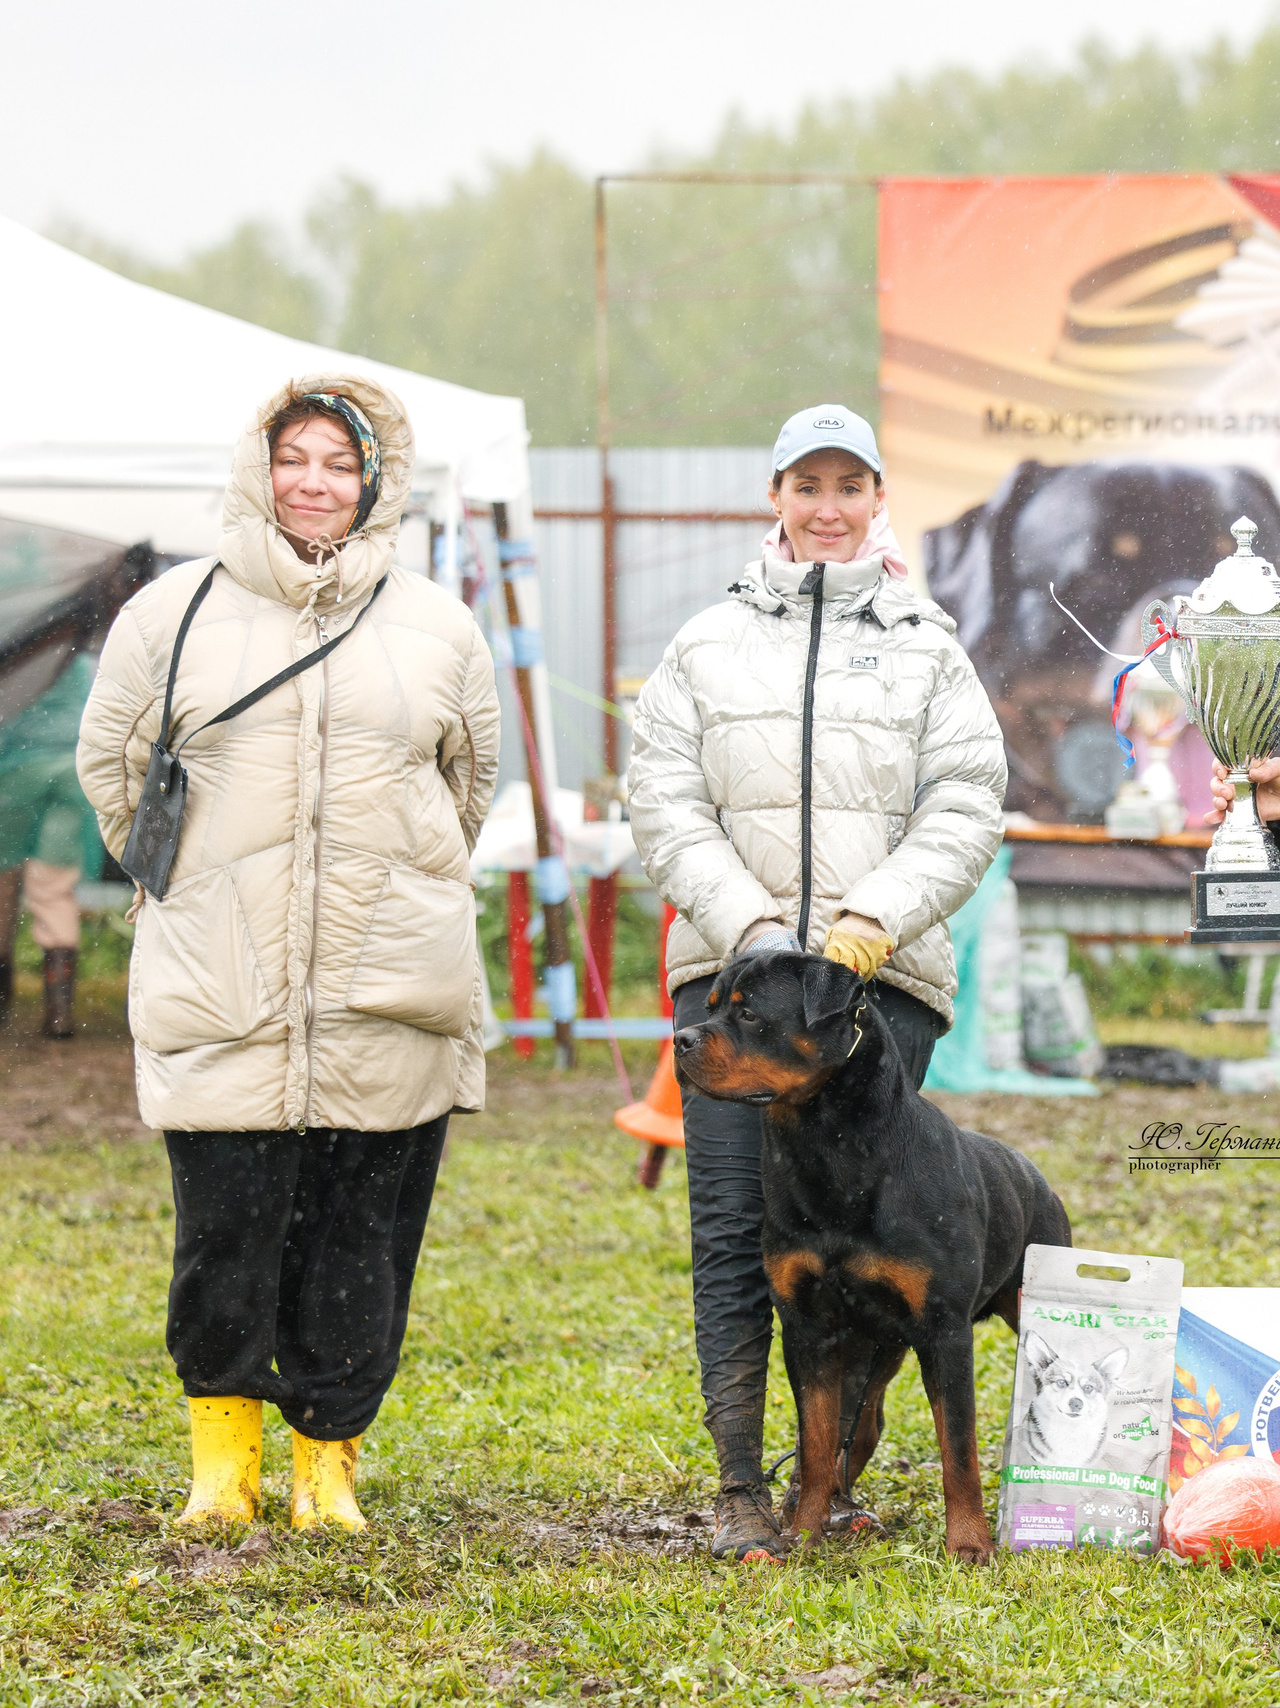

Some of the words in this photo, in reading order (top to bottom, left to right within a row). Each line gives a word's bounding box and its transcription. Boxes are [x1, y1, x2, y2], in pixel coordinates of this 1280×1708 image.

[1032, 1306, 1102, 1328] ACARI
[1112, 1315, 1169, 1328] CIAR
[1143, 1331, 1166, 1340] eco
[1122, 1420, 1150, 1429] natural
[1113, 1430, 1142, 1439] organic
[1013, 1466, 1079, 1482] Professional
[1082, 1470, 1106, 1484] Line
[1109, 1473, 1130, 1489] Dog
[1133, 1476, 1157, 1492] Food
[1020, 1516, 1065, 1524] SUPERBA
